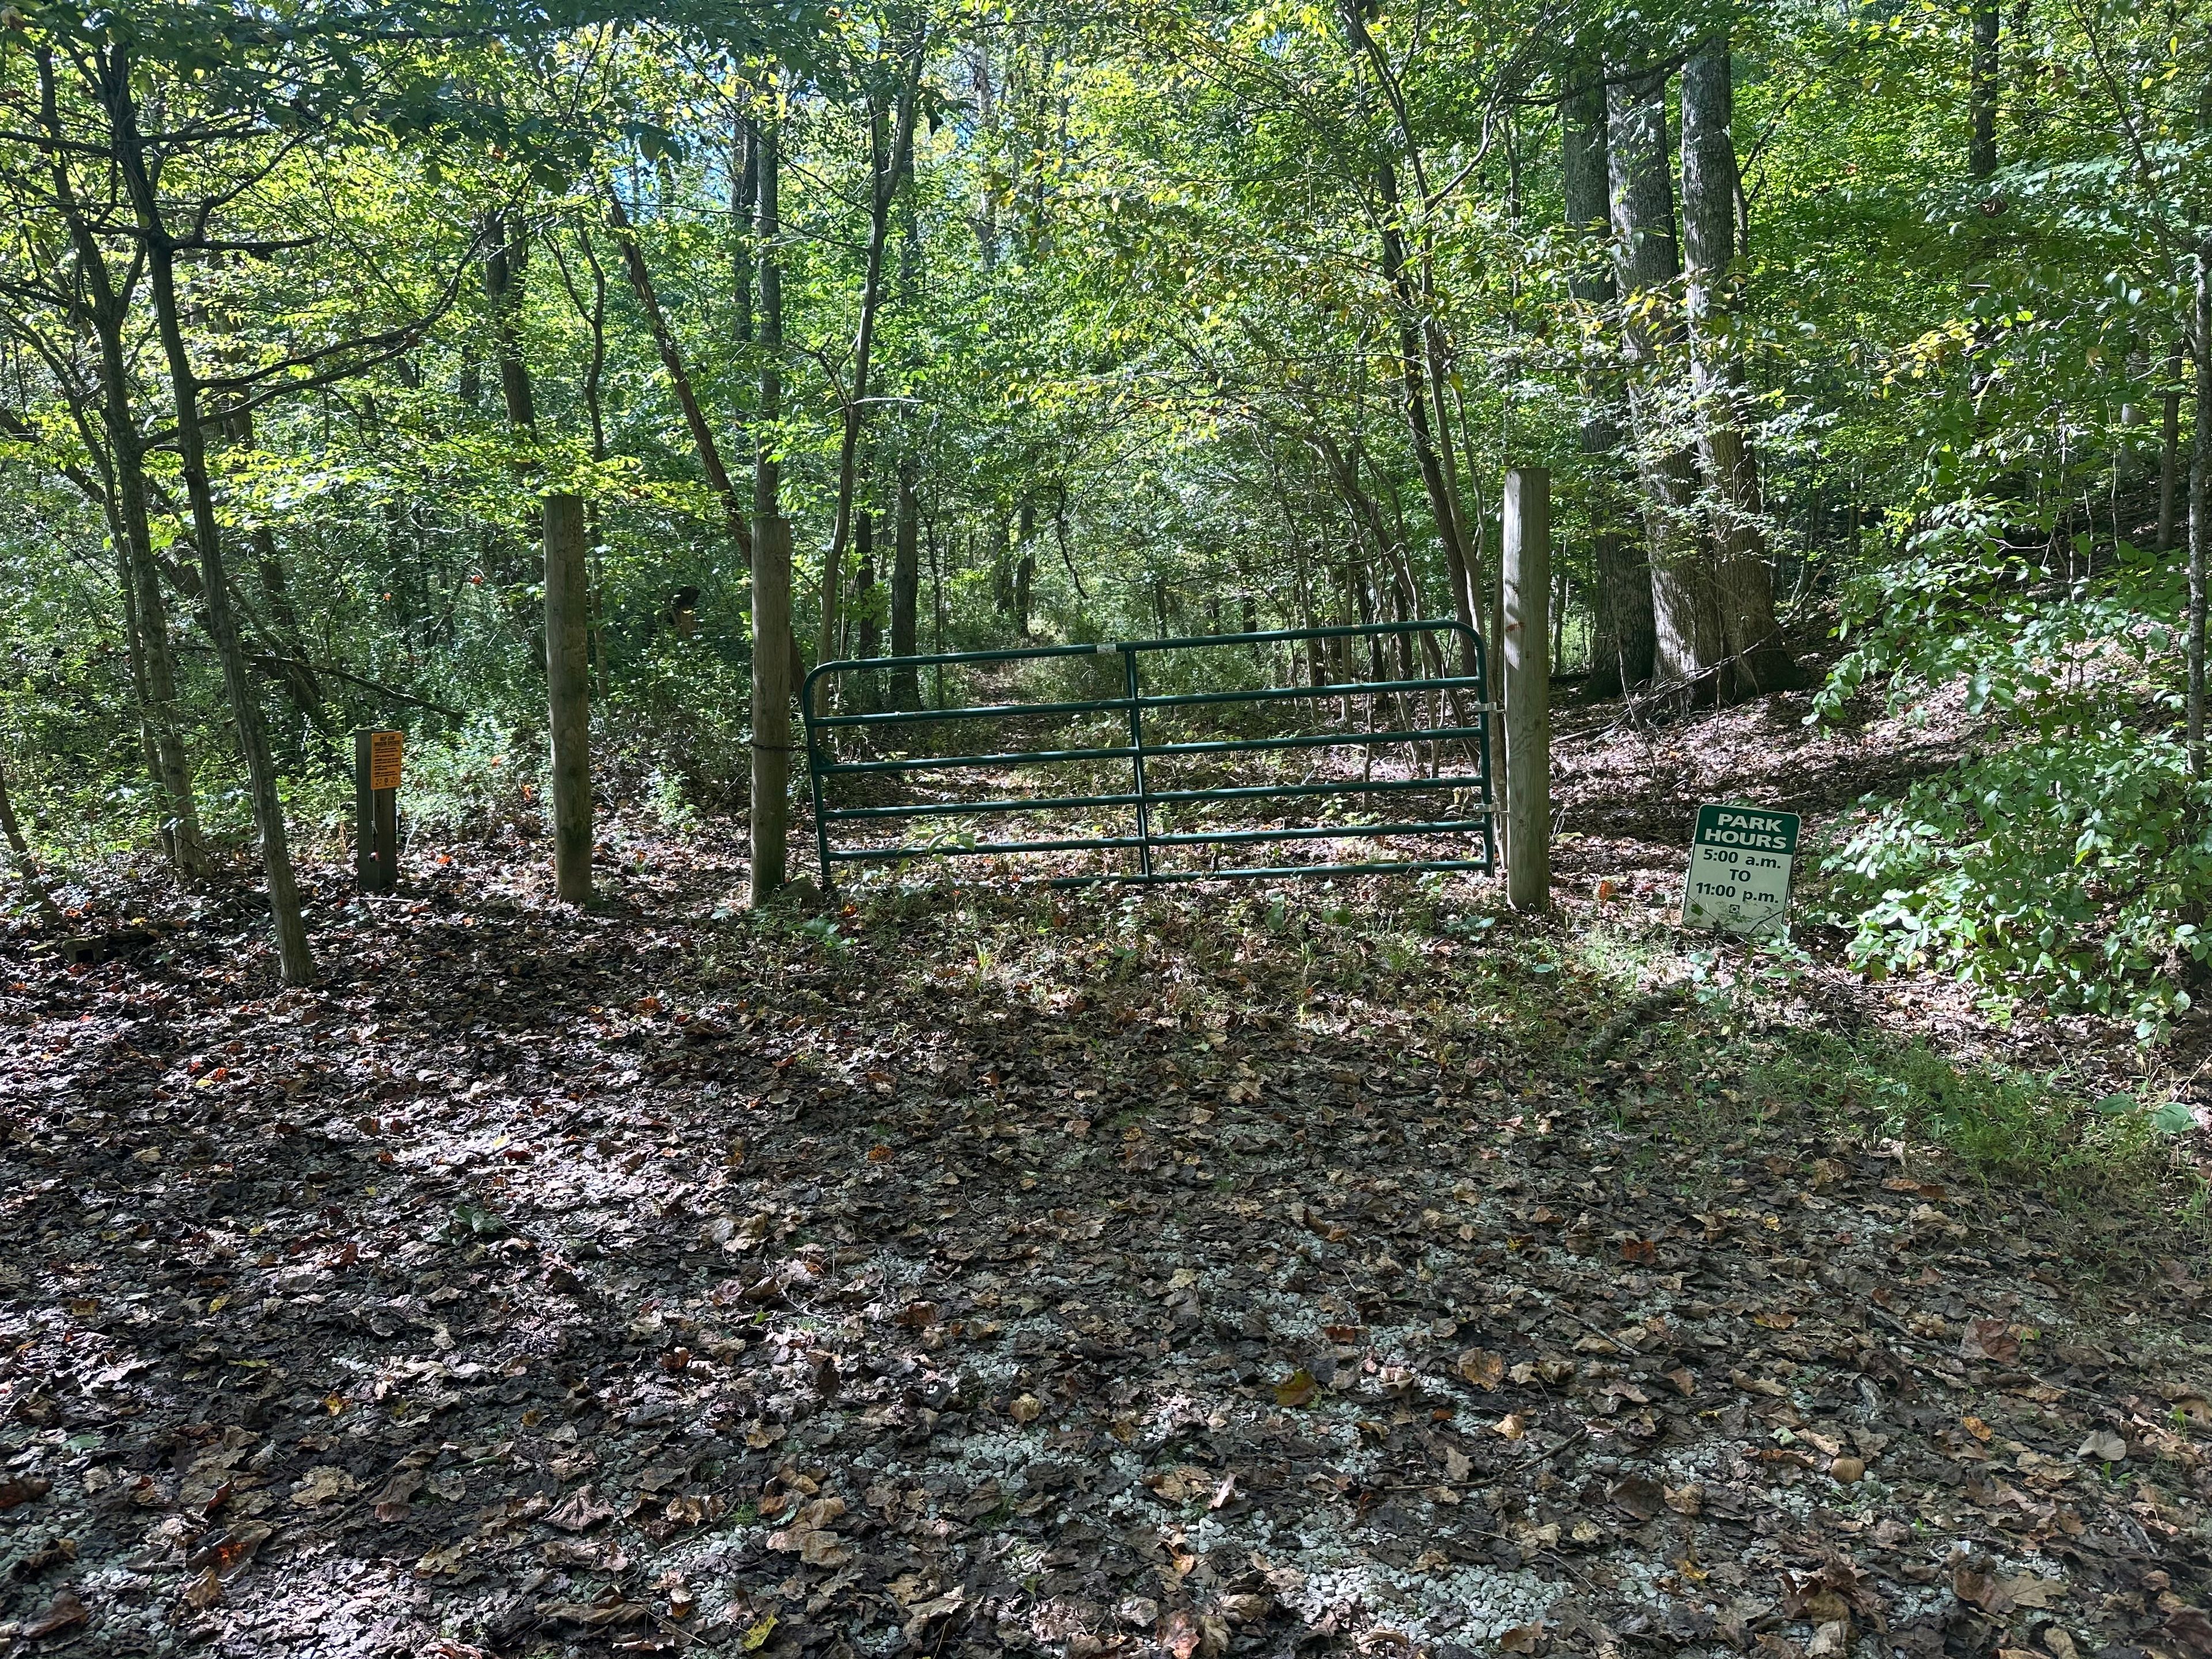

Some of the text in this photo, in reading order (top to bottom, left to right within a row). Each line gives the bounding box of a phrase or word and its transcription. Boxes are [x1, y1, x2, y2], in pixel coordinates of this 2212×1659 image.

[1718, 813, 1783, 832] PARK
[1705, 828, 1787, 849] HOURS
[1703, 849, 1781, 869] 5:00 a.m.
[1729, 869, 1751, 882] TO
[1696, 882, 1779, 903] 11:00 p.m.
